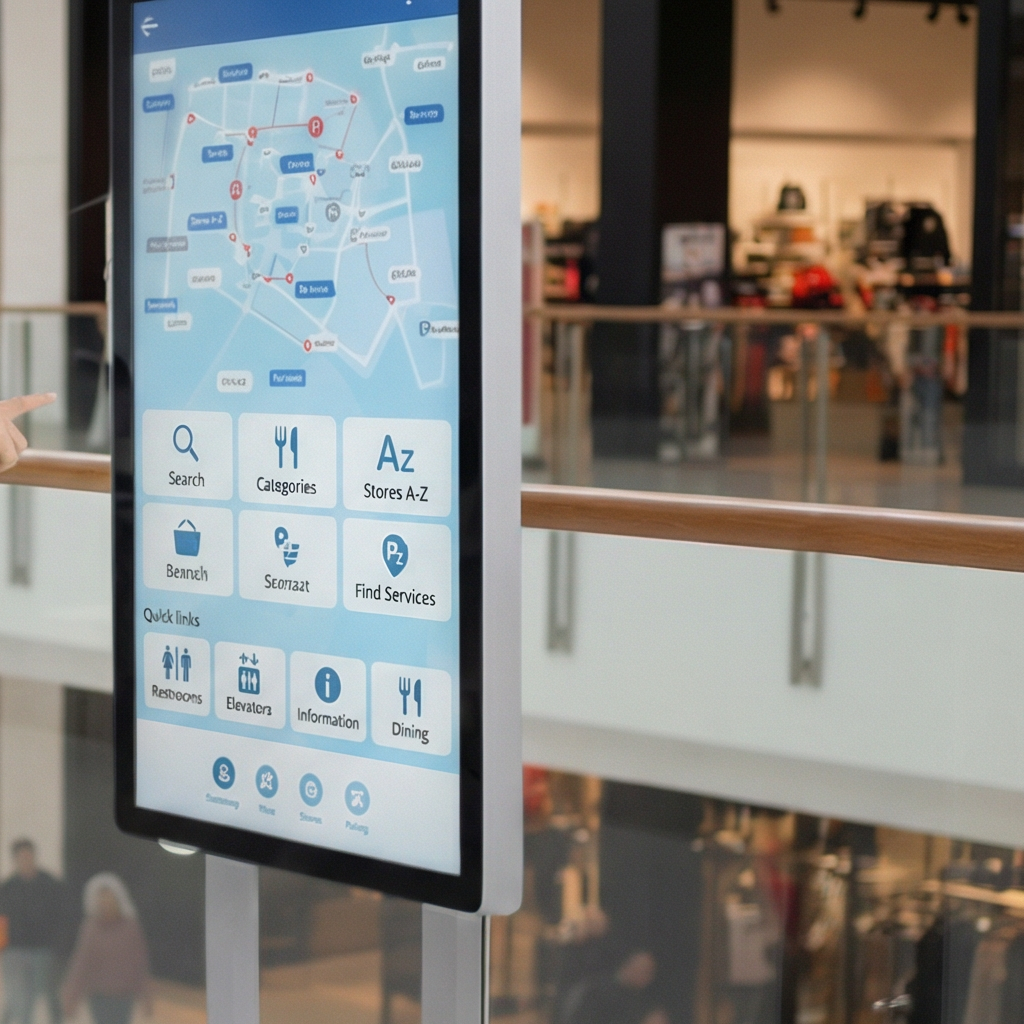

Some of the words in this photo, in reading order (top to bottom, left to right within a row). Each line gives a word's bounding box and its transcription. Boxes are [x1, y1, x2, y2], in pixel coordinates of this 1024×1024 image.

[168, 471, 205, 487] Search
[364, 483, 403, 500] Stores
[405, 485, 429, 502] A-Z
[355, 583, 381, 600] Find
[384, 586, 436, 606] Services
[175, 610, 201, 627] links
[297, 708, 360, 730] Information
[391, 721, 430, 745] Dining
